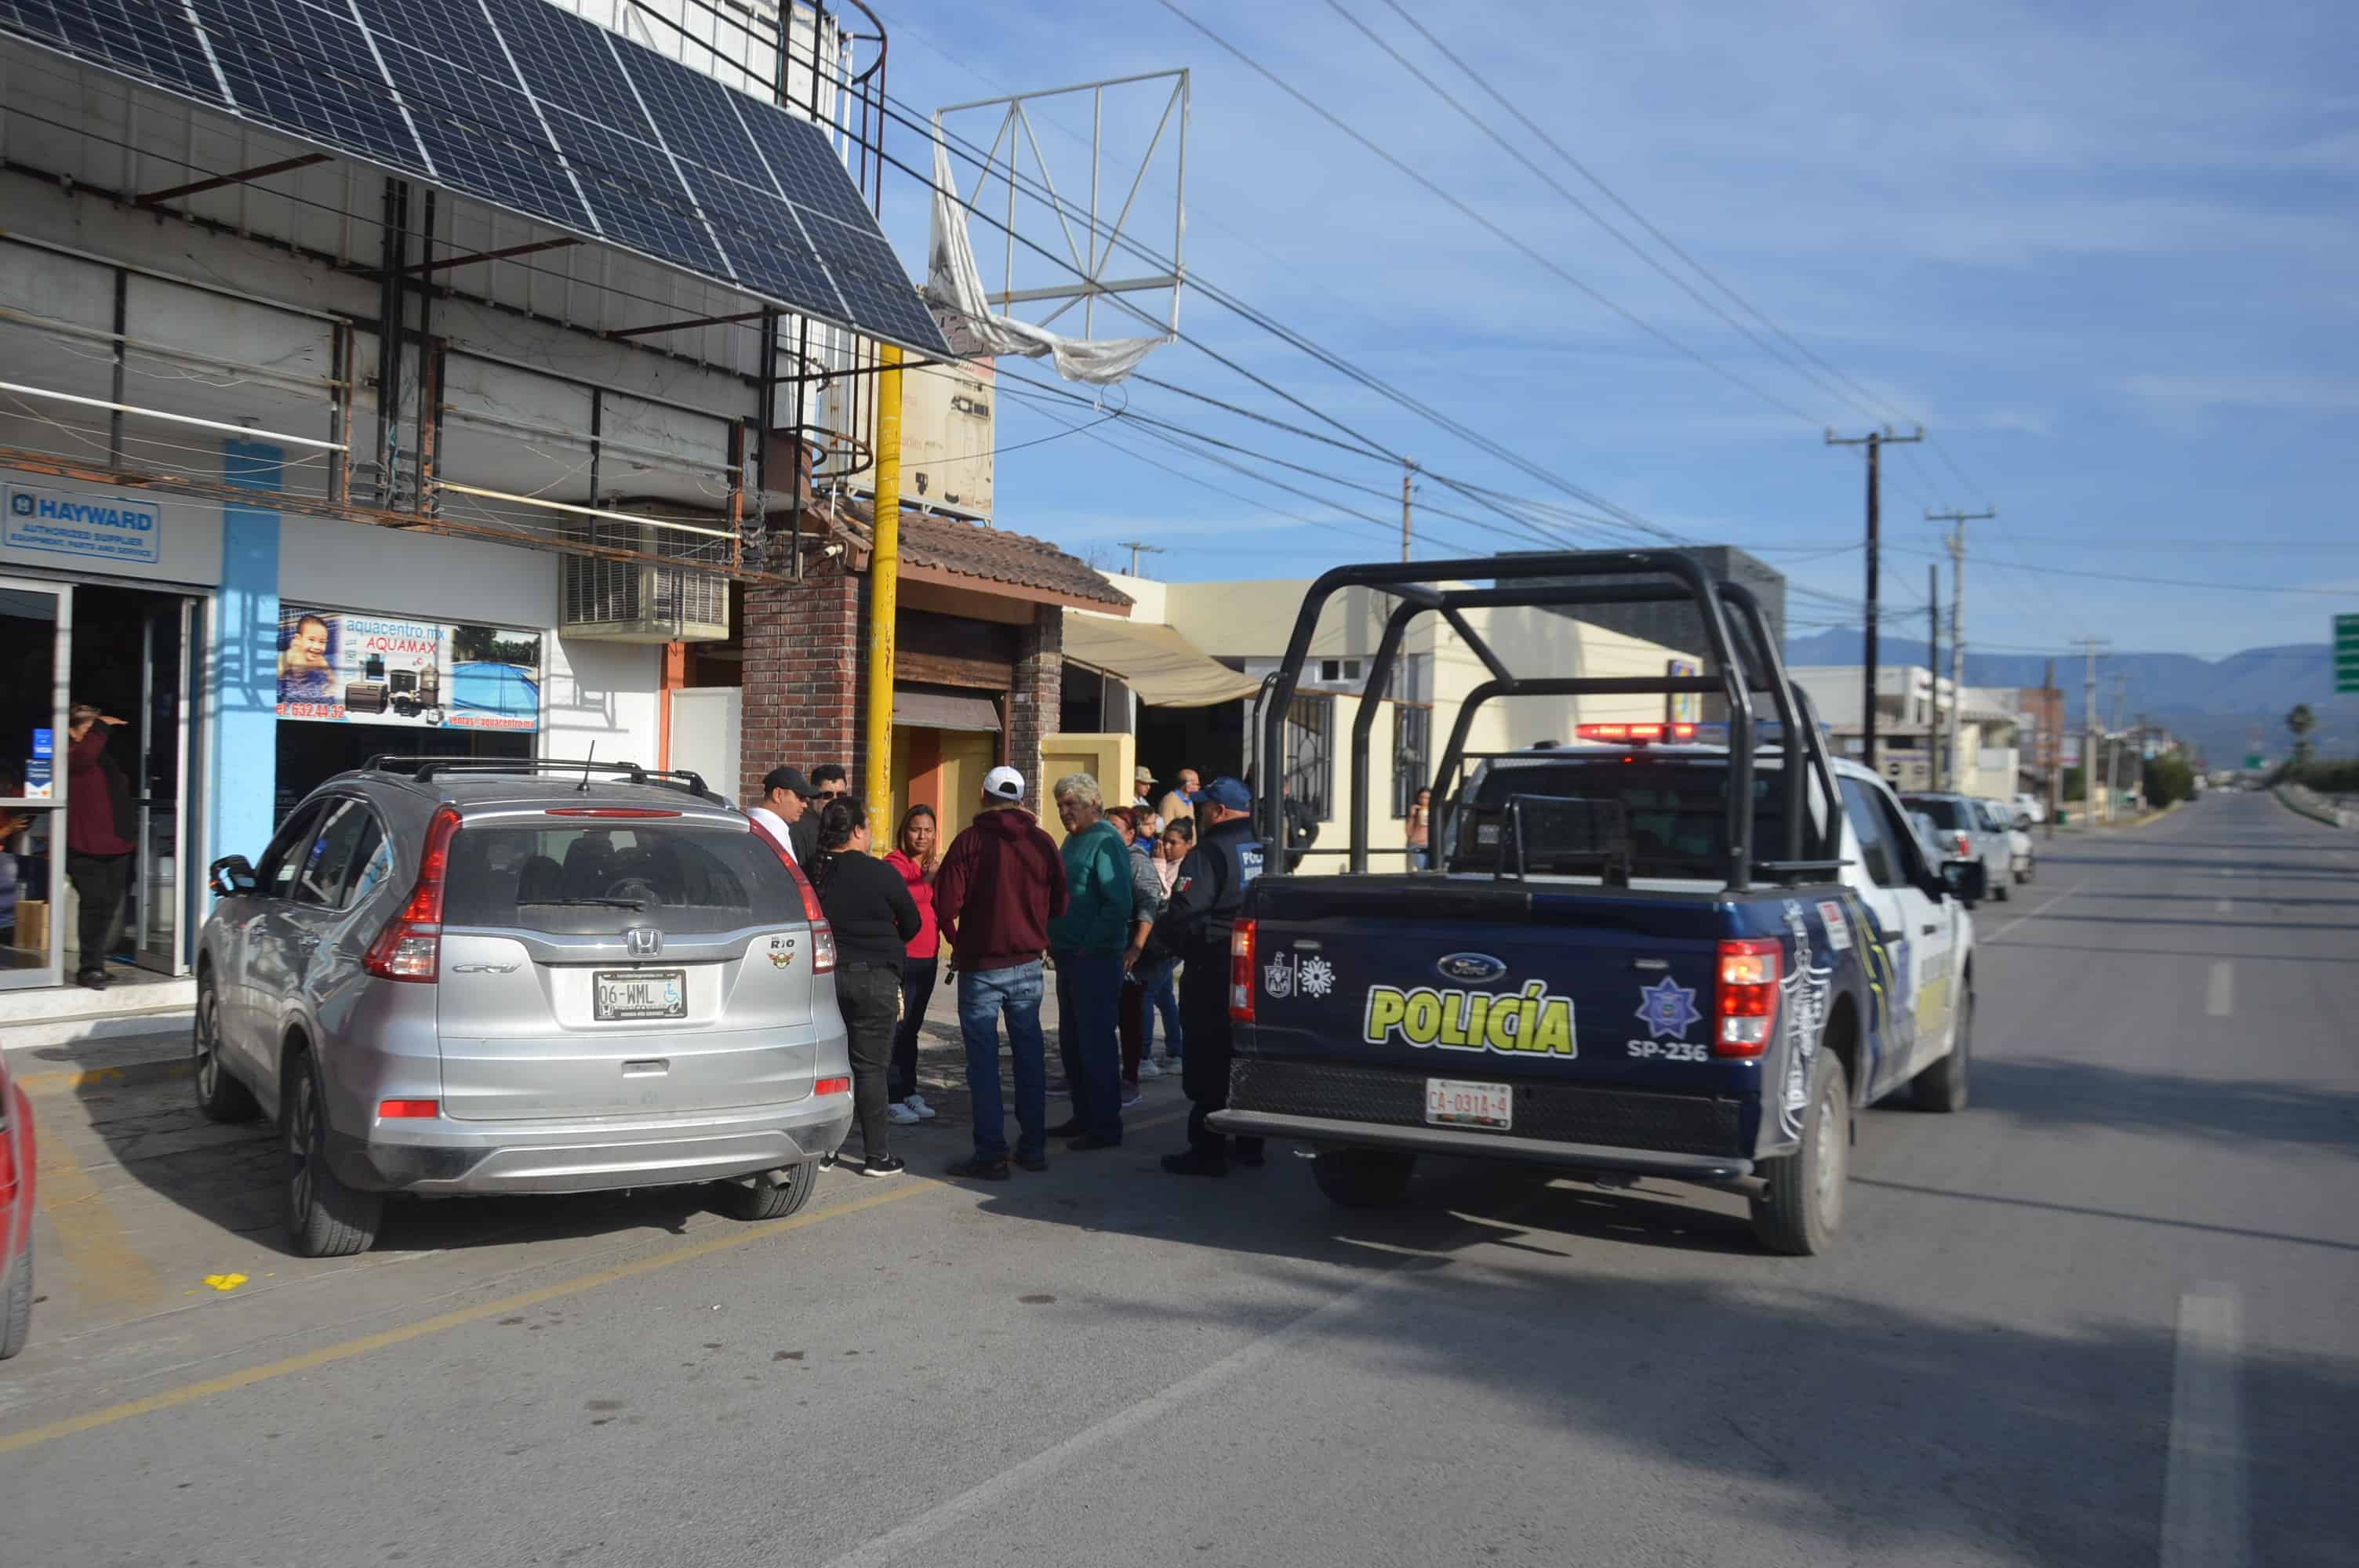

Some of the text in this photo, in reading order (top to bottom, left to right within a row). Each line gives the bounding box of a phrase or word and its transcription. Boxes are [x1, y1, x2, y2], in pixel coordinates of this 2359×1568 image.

[39, 499, 152, 532] HAYWARD
[24, 524, 144, 546] AUTHORIZED SUPPLIER
[346, 619, 445, 641] aquacentro.mx
[366, 637, 437, 654] AQUAMAX
[291, 702, 345, 718] 632.44.32
[600, 984, 654, 1004] 06-WML
[1365, 980, 1577, 1058] POLICÍA
[1627, 1040, 1709, 1062] SP-236
